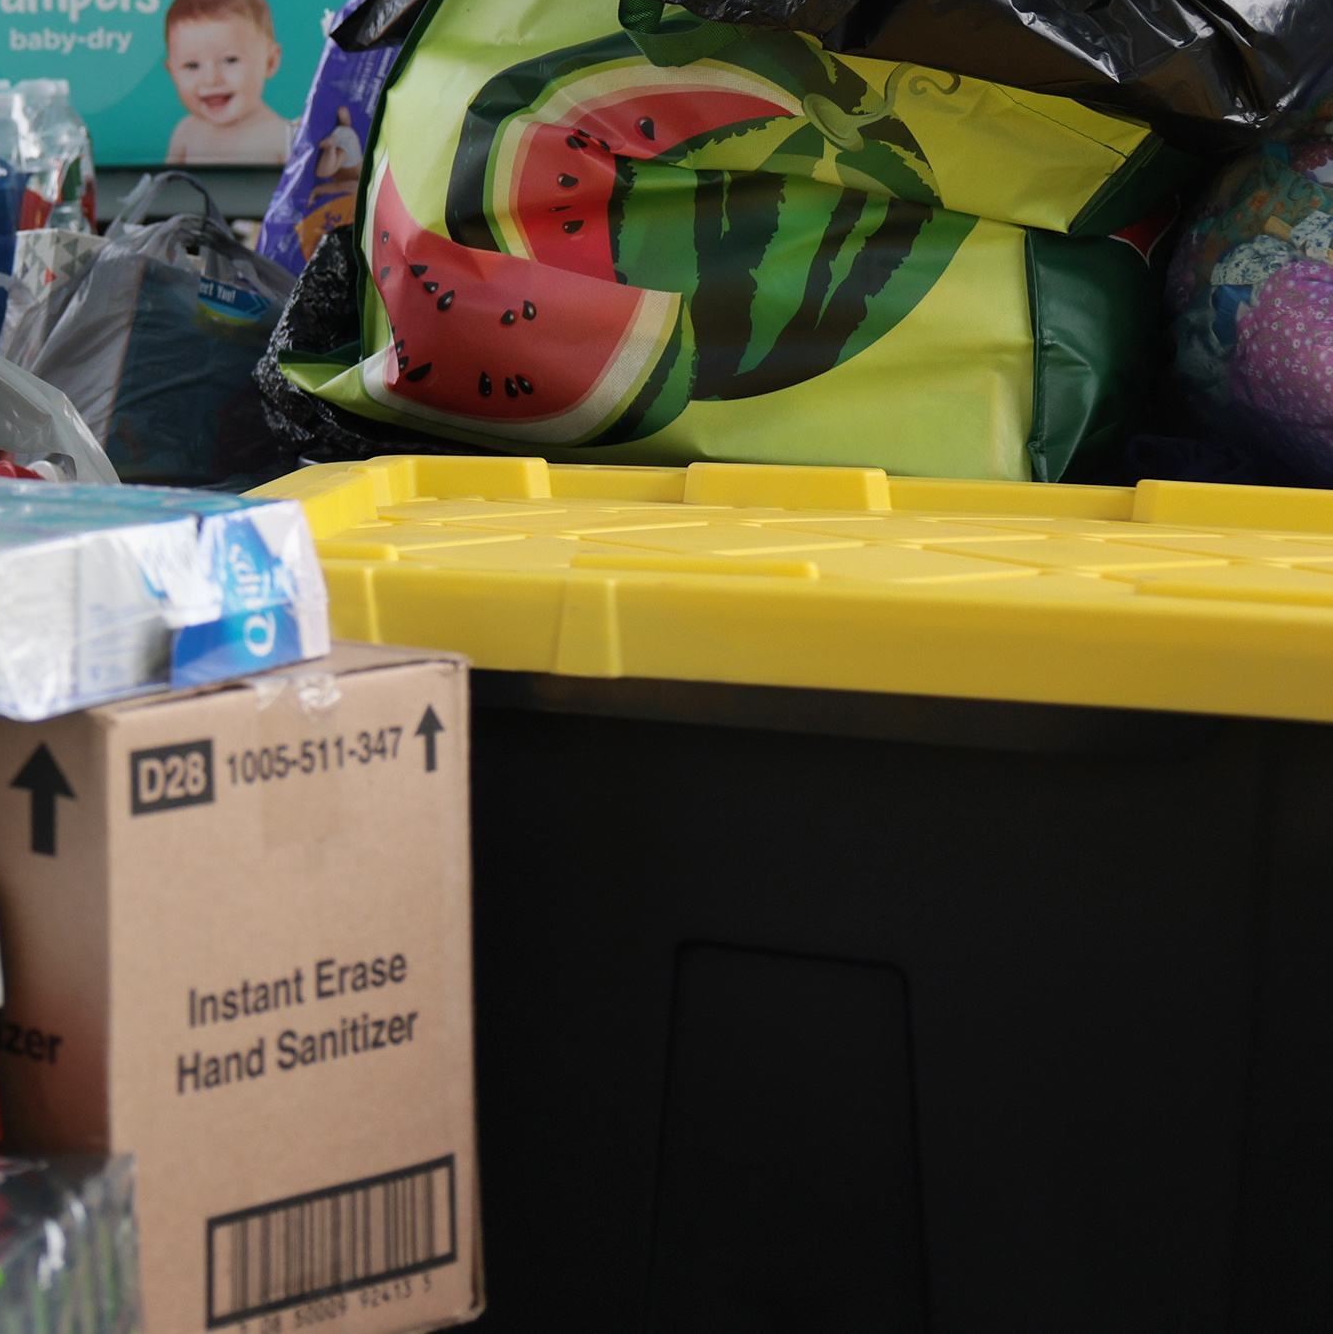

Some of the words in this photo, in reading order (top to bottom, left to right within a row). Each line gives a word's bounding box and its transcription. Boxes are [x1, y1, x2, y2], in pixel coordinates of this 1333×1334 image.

[9, 28, 133, 54] baby-dry
[137, 751, 209, 804] D28
[227, 726, 403, 785] 1005-511-347
[189, 964, 305, 1029] Instant
[315, 950, 409, 1000] Erase
[177, 1031, 265, 1095] Hand
[275, 1006, 420, 1074] Sanitizer
